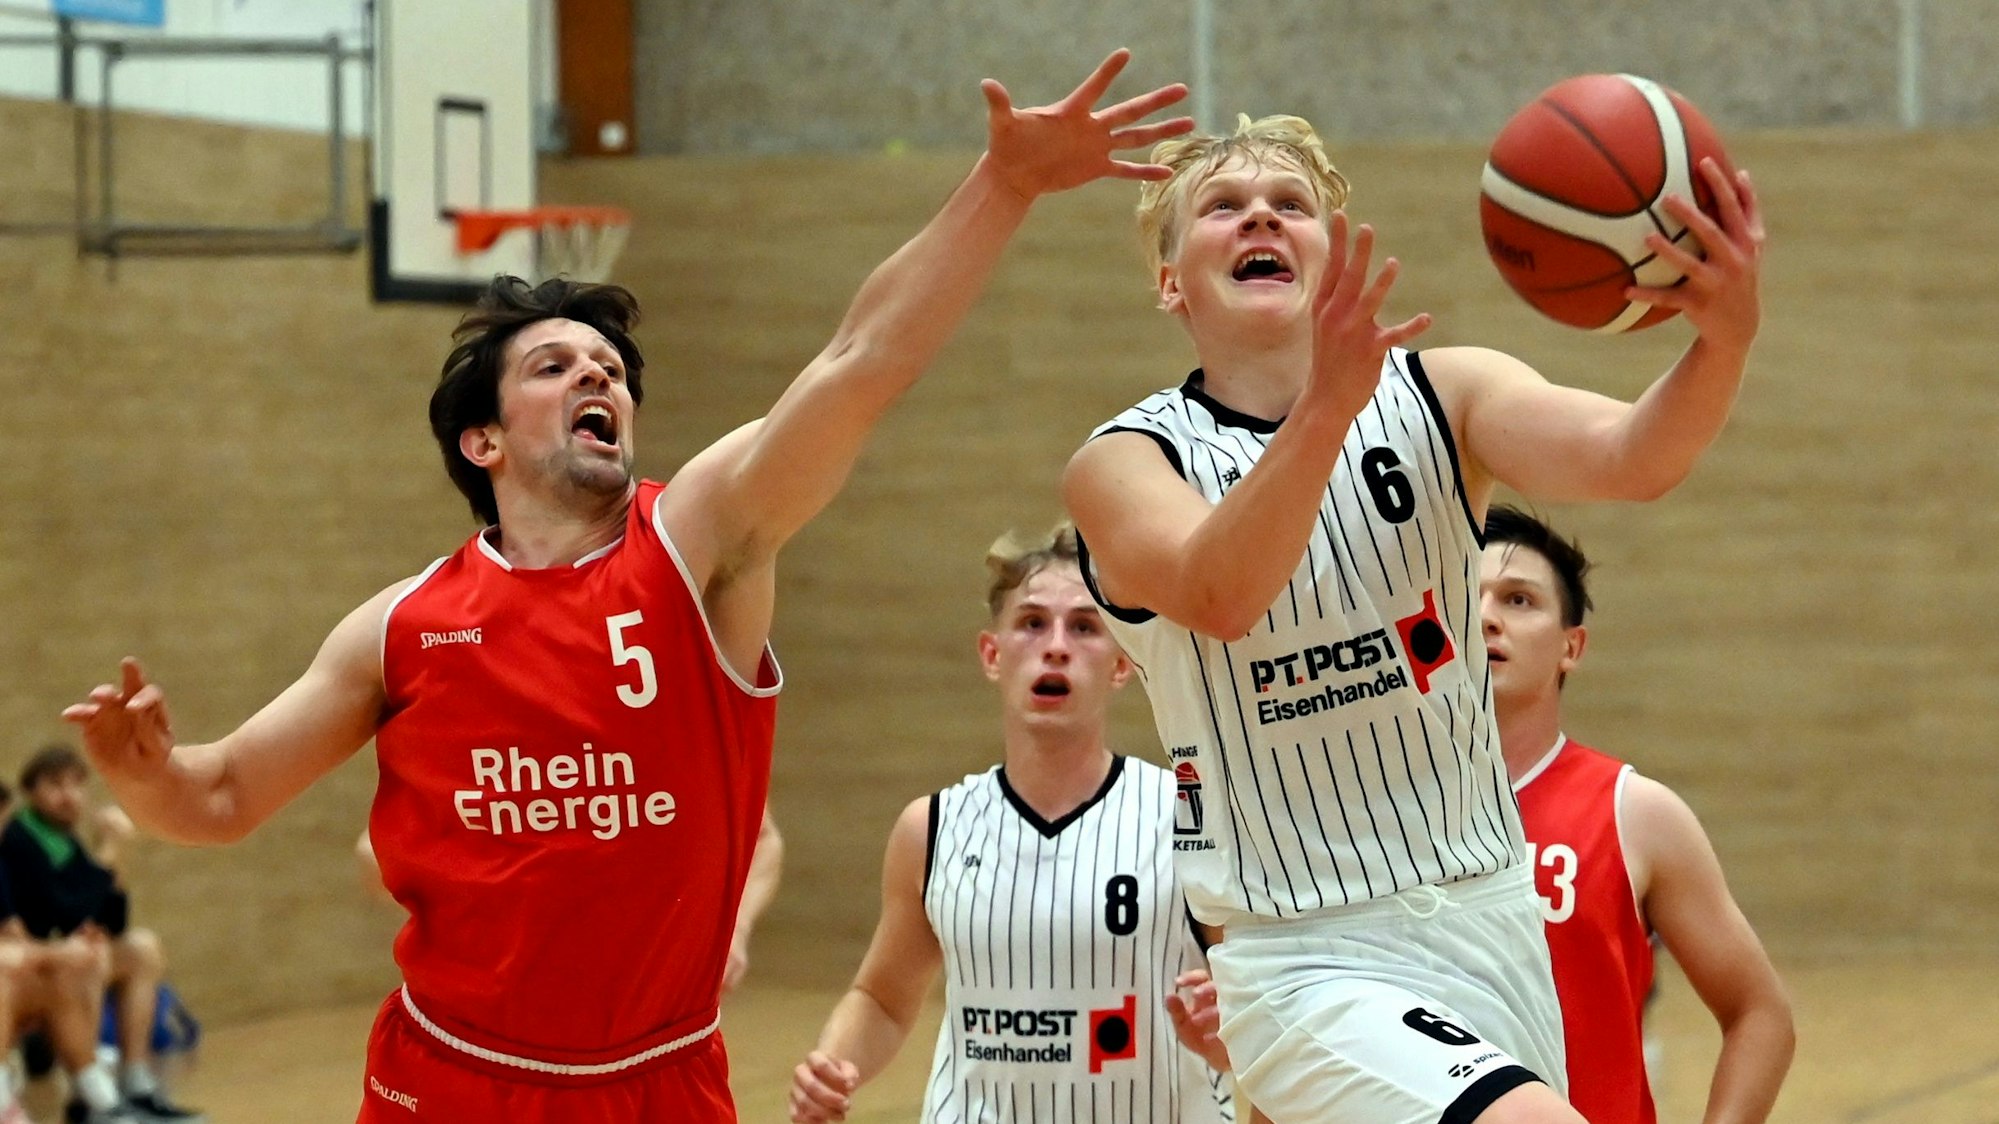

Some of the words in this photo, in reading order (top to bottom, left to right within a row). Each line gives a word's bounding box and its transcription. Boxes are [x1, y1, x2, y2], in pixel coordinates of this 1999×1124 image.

[1361, 446, 1415, 524] 6
[420, 627, 482, 650] SPALDING
[605, 609, 658, 708] 5
[1304, 628, 1397, 681] POST
[1257, 665, 1409, 725] Eisenhandel
[471, 743, 635, 792] Rhein
[454, 789, 676, 840] Energie
[1105, 874, 1139, 936] 8
[995, 1009, 1078, 1036] POST
[1402, 1007, 1481, 1046] 6
[965, 1039, 1071, 1063] Eisenhandel
[370, 1075, 418, 1113] SPALDING
